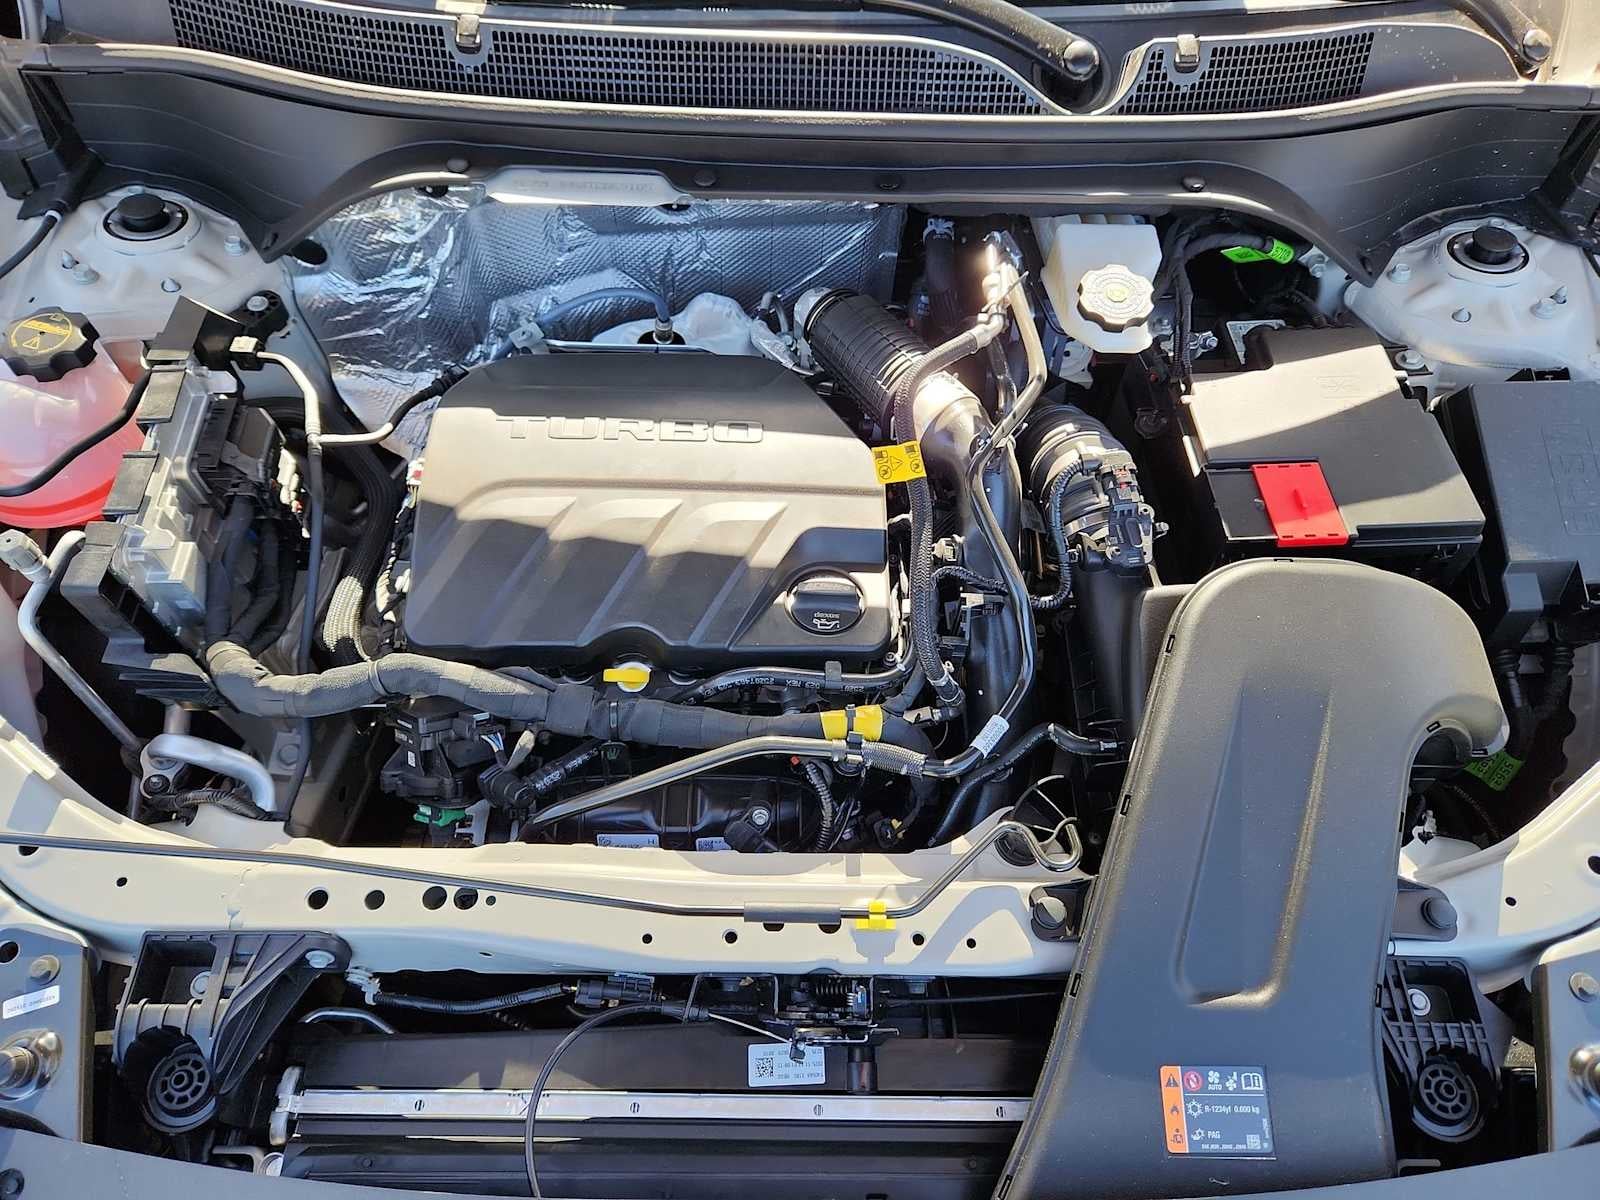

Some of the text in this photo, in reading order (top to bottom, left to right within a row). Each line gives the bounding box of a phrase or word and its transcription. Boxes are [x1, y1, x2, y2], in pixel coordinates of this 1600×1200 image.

[495, 416, 764, 444] TURBO
[1251, 1104, 1260, 1115] kg
[1207, 1130, 1221, 1139] PAG
